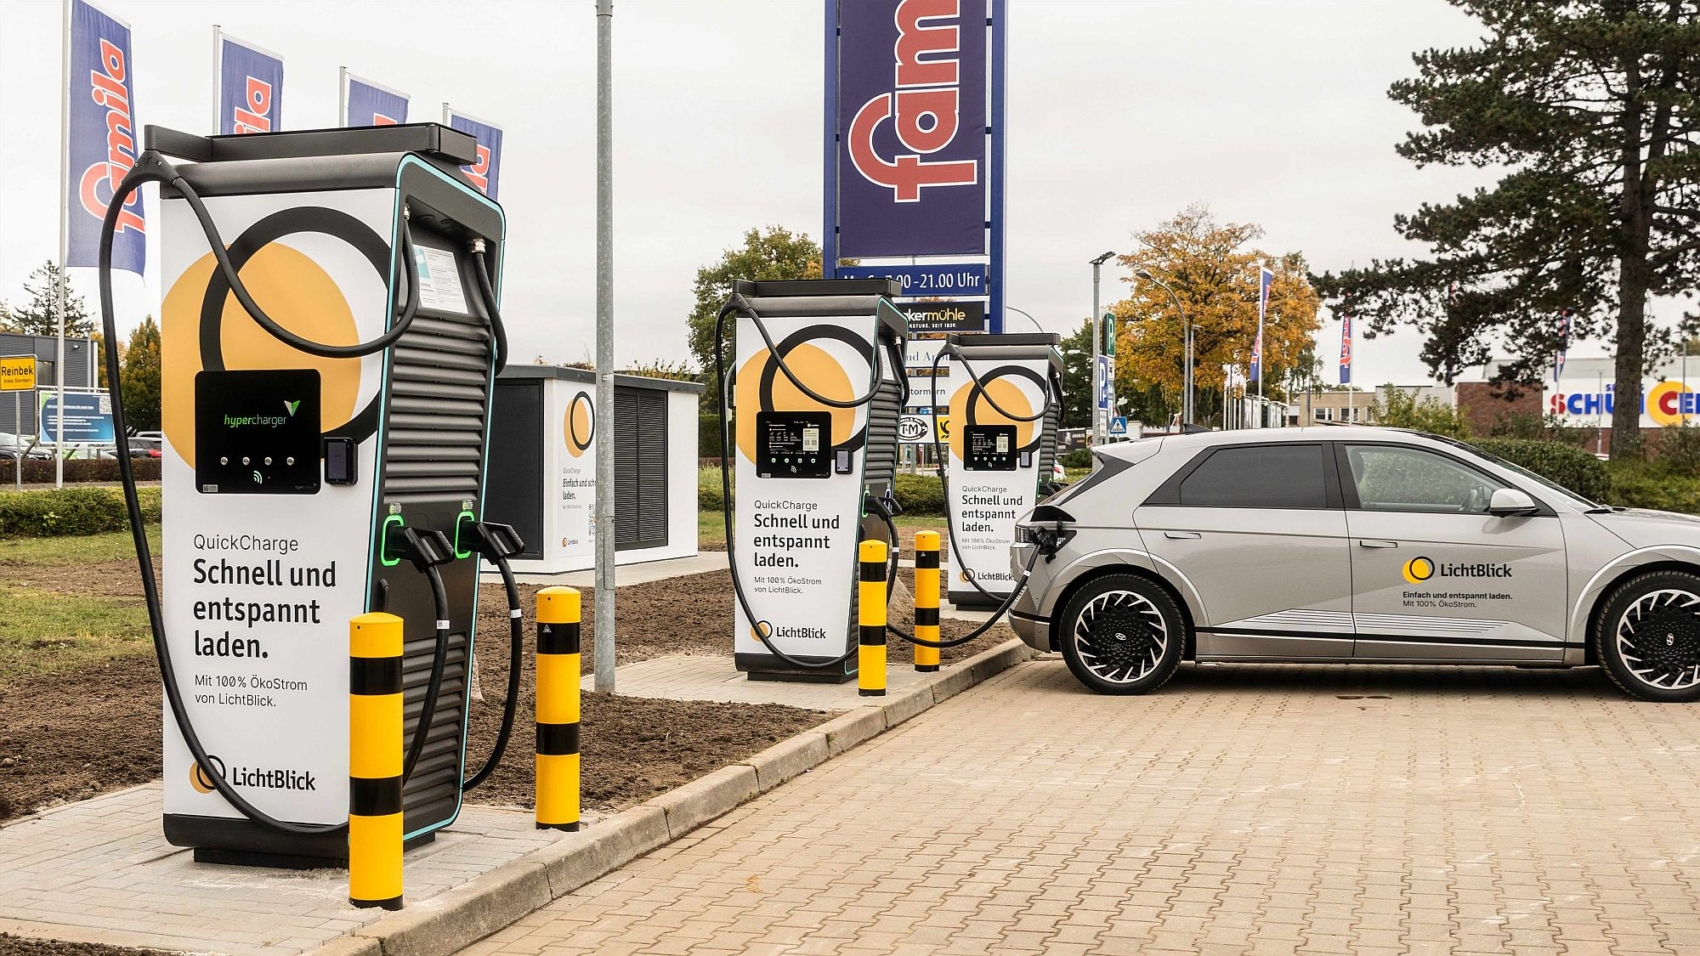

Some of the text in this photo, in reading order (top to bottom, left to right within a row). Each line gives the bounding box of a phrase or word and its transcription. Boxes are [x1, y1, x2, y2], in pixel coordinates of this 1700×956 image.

[79, 38, 146, 234] famila
[957, 272, 980, 288] Uhr
[1108, 318, 1114, 349] P
[2, 365, 33, 376] Reinbek
[224, 413, 287, 428] hypercharger
[562, 478, 579, 488] Einfach
[580, 478, 588, 487] und
[962, 485, 1008, 494] QuickCharge
[562, 490, 576, 500] laden.
[961, 494, 1023, 506] Schnell und
[754, 500, 818, 512] QuickCharge
[754, 513, 840, 529] Schnell und
[961, 509, 1016, 521] entspannt
[962, 521, 994, 532] laden.
[193, 533, 299, 555] QuickCharge
[753, 534, 830, 551] entspannt
[754, 552, 799, 568] laden.
[193, 557, 336, 587] Schnell und
[1440, 563, 1512, 578] LichtBlick
[788, 576, 822, 585] ÖkoStrom
[768, 586, 804, 594] LichtBlick.
[1402, 591, 1431, 599] Einfach
[1432, 591, 1447, 599] und
[1448, 592, 1487, 600] entspannt
[1438, 600, 1478, 608] ÖkoStrom.
[193, 597, 321, 628] entspannt
[776, 627, 827, 639] LichtBlick
[194, 629, 269, 659] laden.
[194, 674, 213, 687] Mit
[250, 674, 308, 691] ÖkoStrom
[194, 693, 277, 707] von LichtBlick.
[233, 767, 316, 791] LichtBlick
